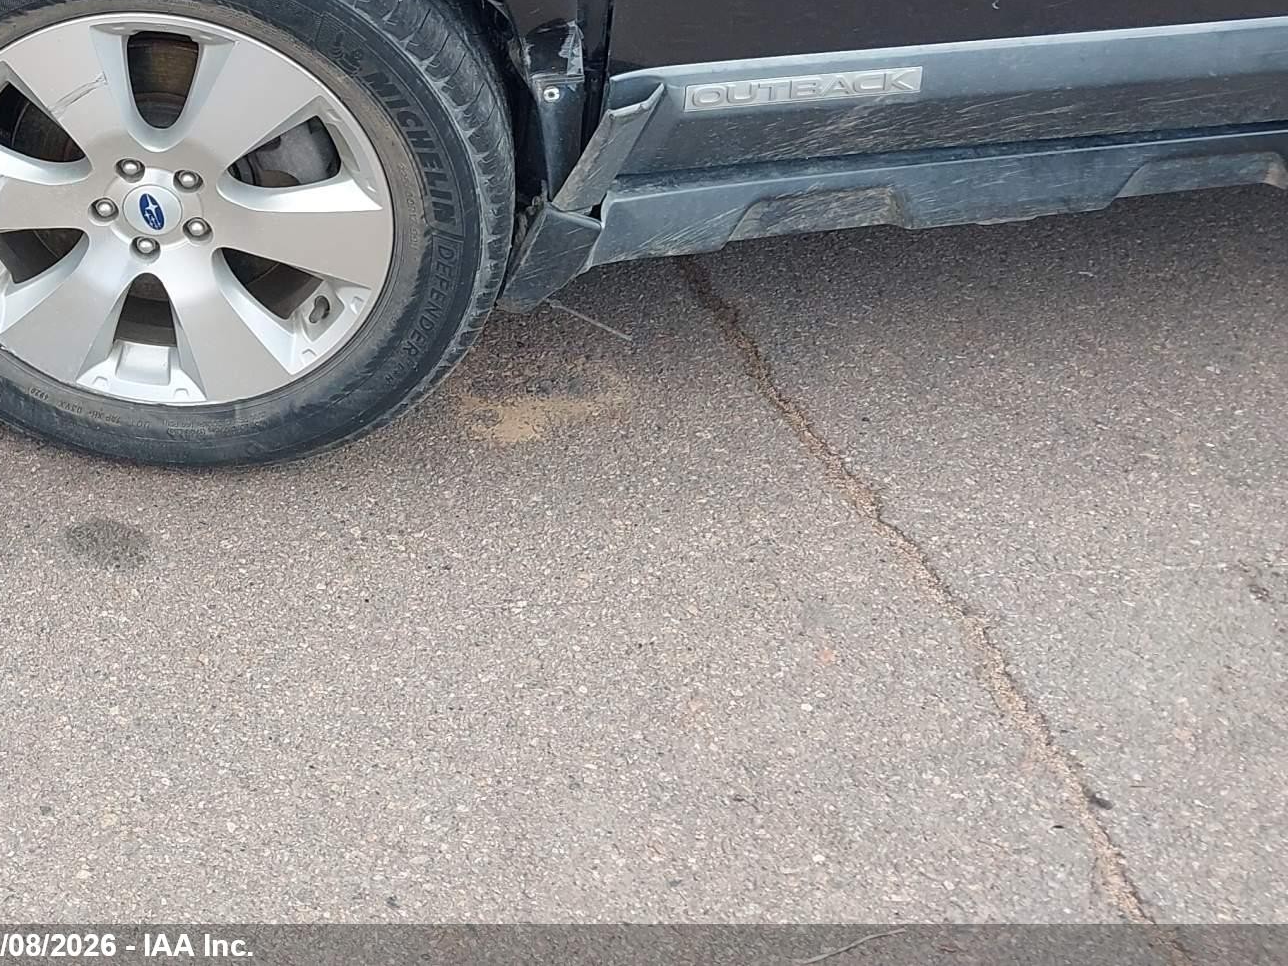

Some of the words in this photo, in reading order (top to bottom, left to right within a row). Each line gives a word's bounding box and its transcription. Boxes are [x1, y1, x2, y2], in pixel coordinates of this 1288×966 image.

[363, 70, 458, 228] MICHELIN
[692, 68, 918, 108] OUTBACK
[401, 244, 455, 366] DEFENDER
